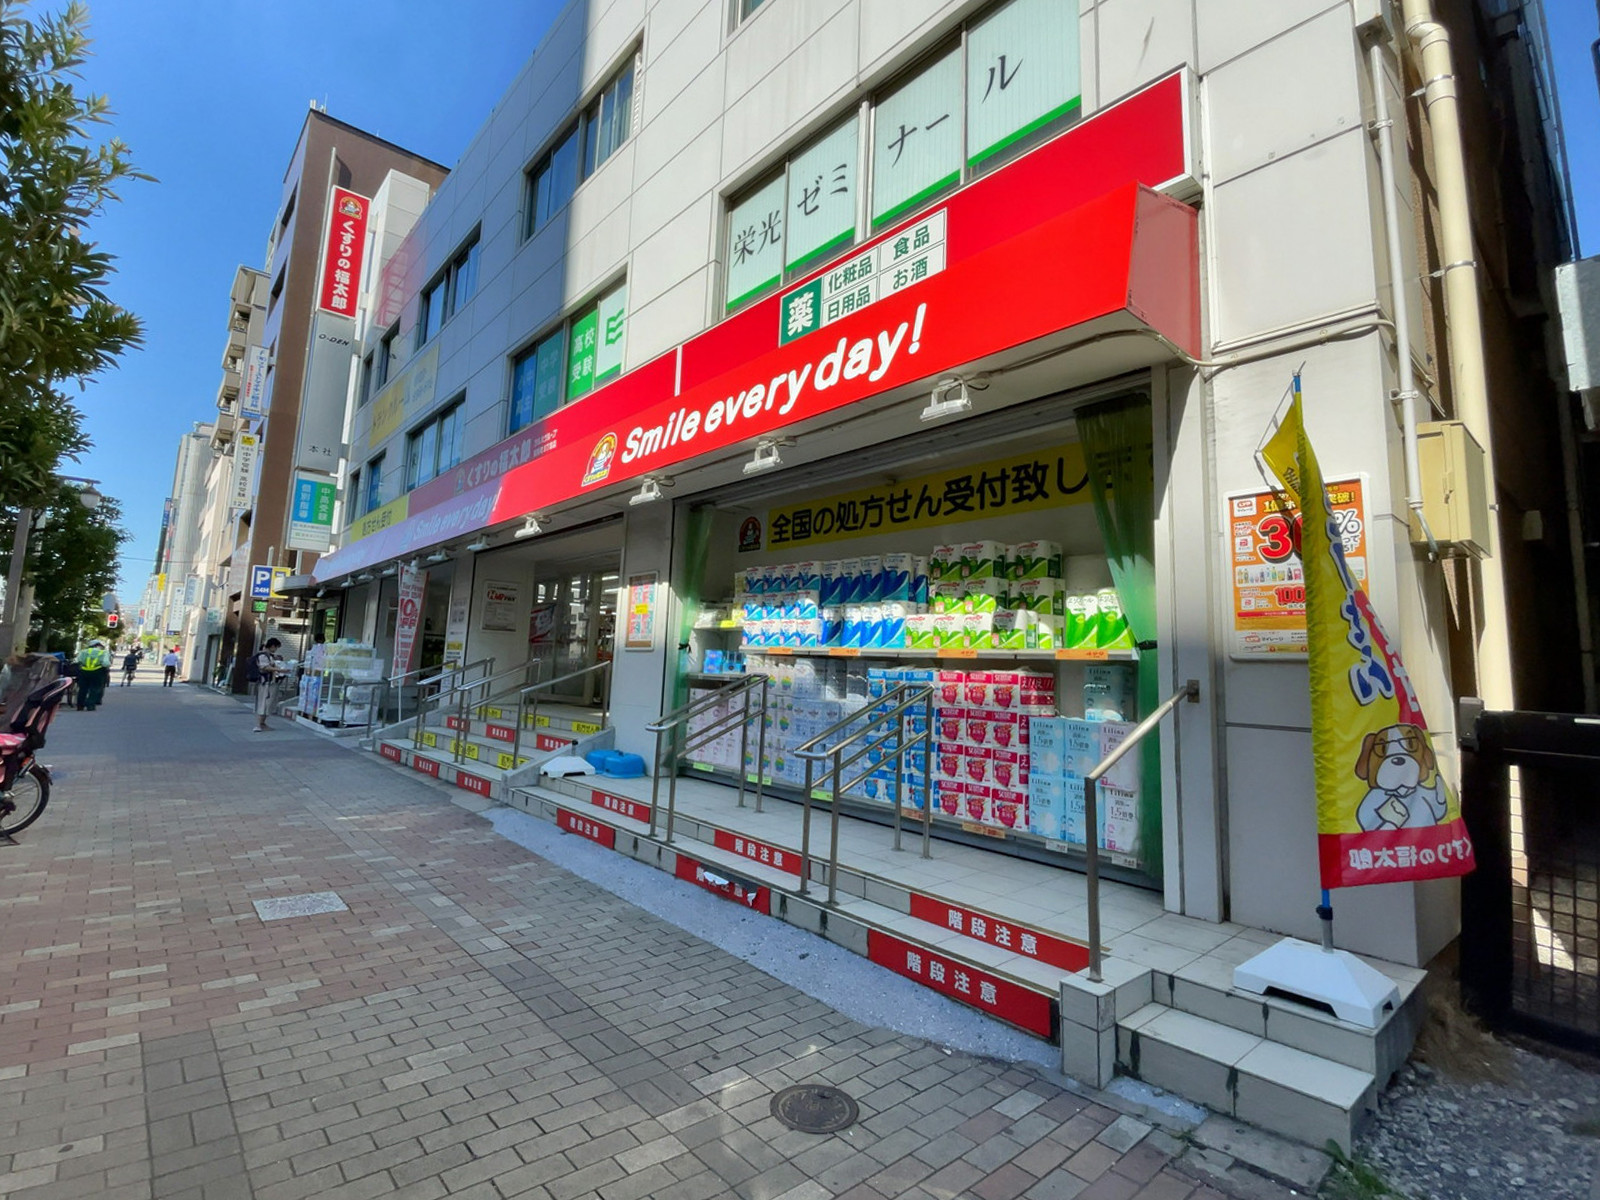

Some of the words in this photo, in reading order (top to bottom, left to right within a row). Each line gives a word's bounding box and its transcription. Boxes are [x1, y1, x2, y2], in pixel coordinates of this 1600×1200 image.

[893, 224, 930, 260] 食品
[331, 220, 355, 310] くすりの福太郎
[827, 255, 873, 293] 化粧品
[892, 255, 928, 290] お酒
[787, 291, 814, 337] 薬
[827, 286, 871, 322] 日用品
[319, 333, 350, 346] O-DEN
[573, 326, 595, 356] 高校
[571, 355, 594, 384] 受験
[309, 445, 332, 456] 本社
[621, 407, 700, 465] Smile
[771, 443, 1152, 544] 全国の処方せん受付致し
[256, 570, 271, 585] P
[735, 838, 783, 867] 階段注意
[948, 909, 1038, 955] 階段注意
[906, 950, 998, 1006] 階段注意
